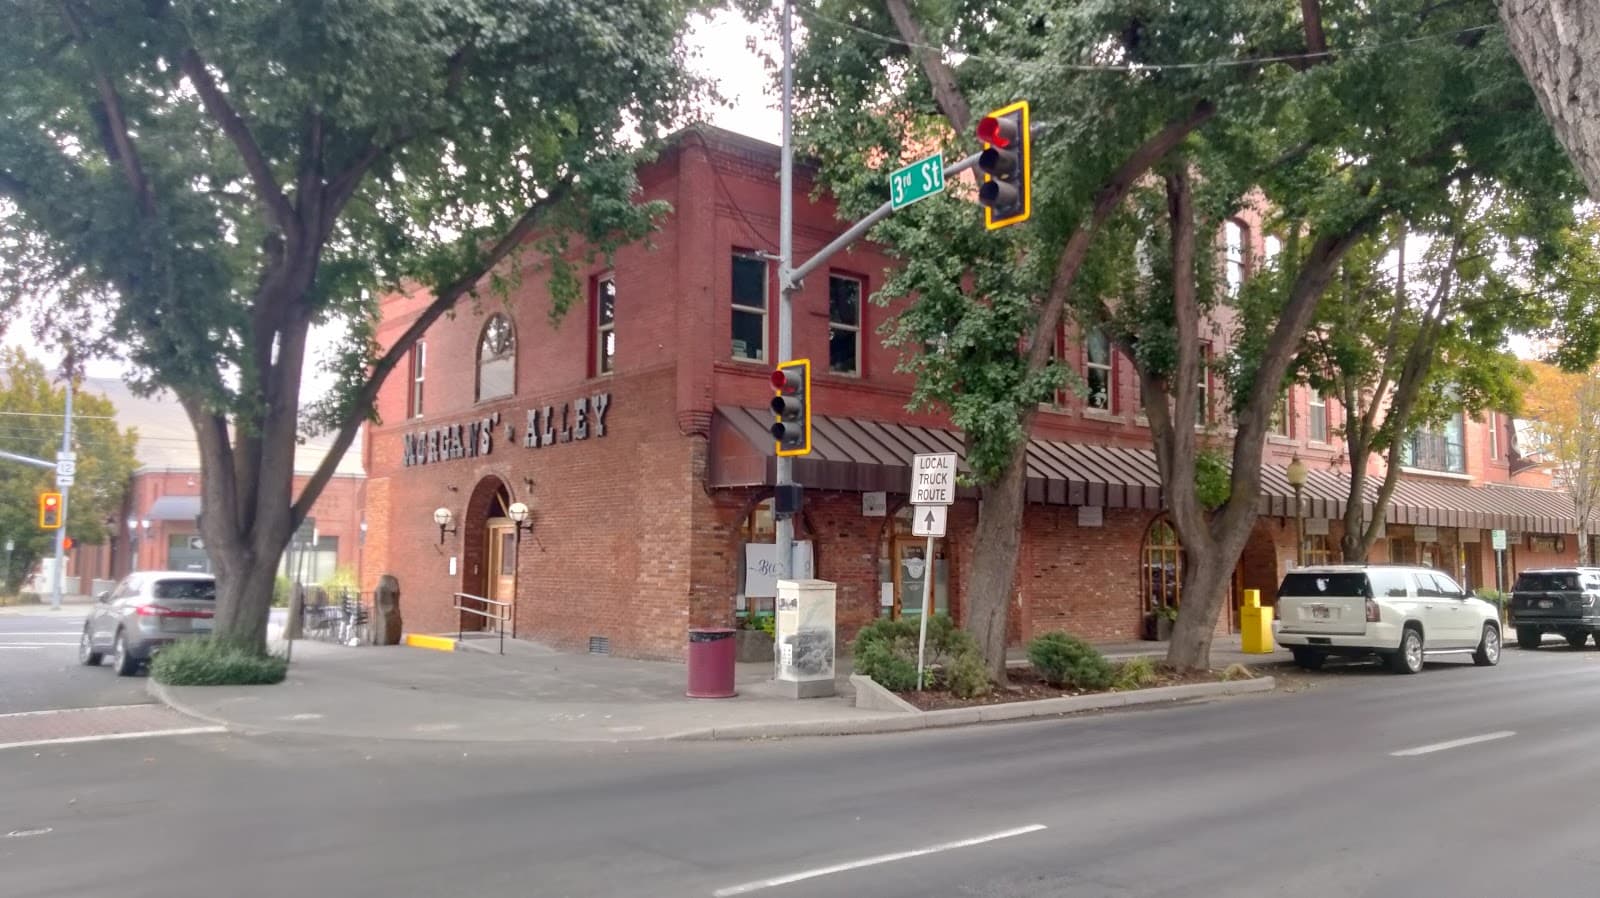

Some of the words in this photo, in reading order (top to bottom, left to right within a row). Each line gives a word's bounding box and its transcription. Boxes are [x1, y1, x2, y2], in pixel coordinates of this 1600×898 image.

[893, 173, 912, 204] 3rd
[921, 161, 941, 192] St
[523, 393, 611, 449] ALLEY
[919, 457, 949, 470] LOCAL
[919, 473, 948, 485] TRUCK
[917, 489, 947, 501] ROUTE
